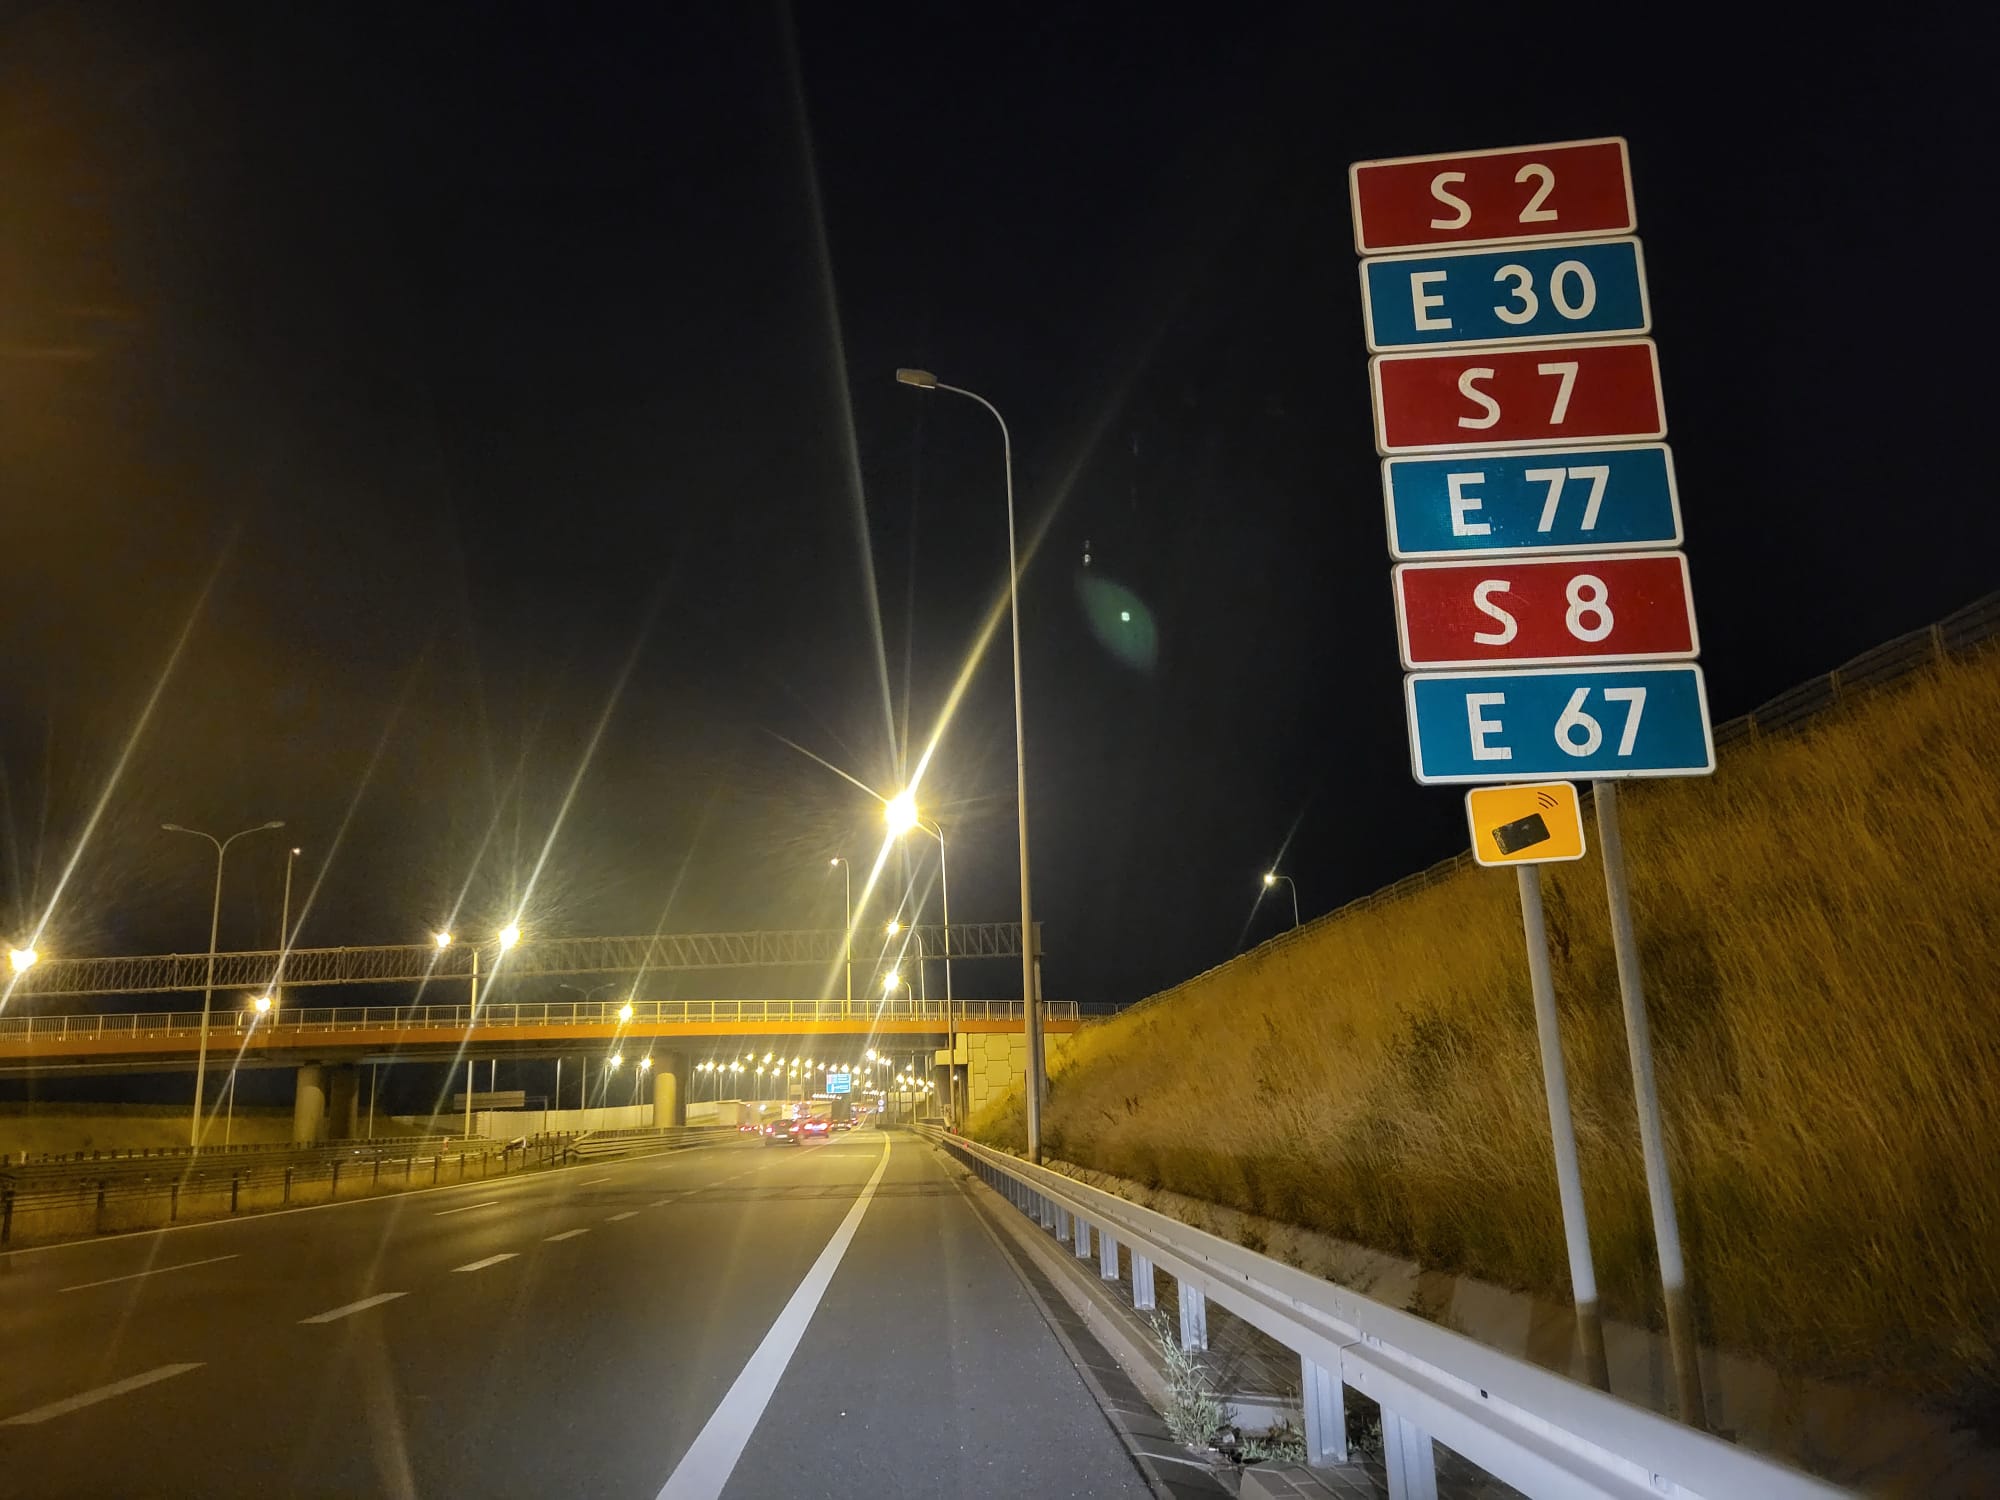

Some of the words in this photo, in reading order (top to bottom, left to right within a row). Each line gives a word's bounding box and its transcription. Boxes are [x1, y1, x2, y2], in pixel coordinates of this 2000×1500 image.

[1430, 172, 1472, 230] S
[1515, 163, 1558, 223] 2
[1410, 270, 1453, 331] E
[1493, 260, 1597, 325] 30
[1457, 367, 1501, 430] S
[1537, 361, 1579, 425] 7
[1446, 471, 1492, 537] E
[1524, 465, 1610, 533] 77
[1473, 579, 1518, 646] S
[1565, 574, 1614, 643] 8
[1465, 692, 1513, 761] E
[1554, 686, 1647, 757] 67
